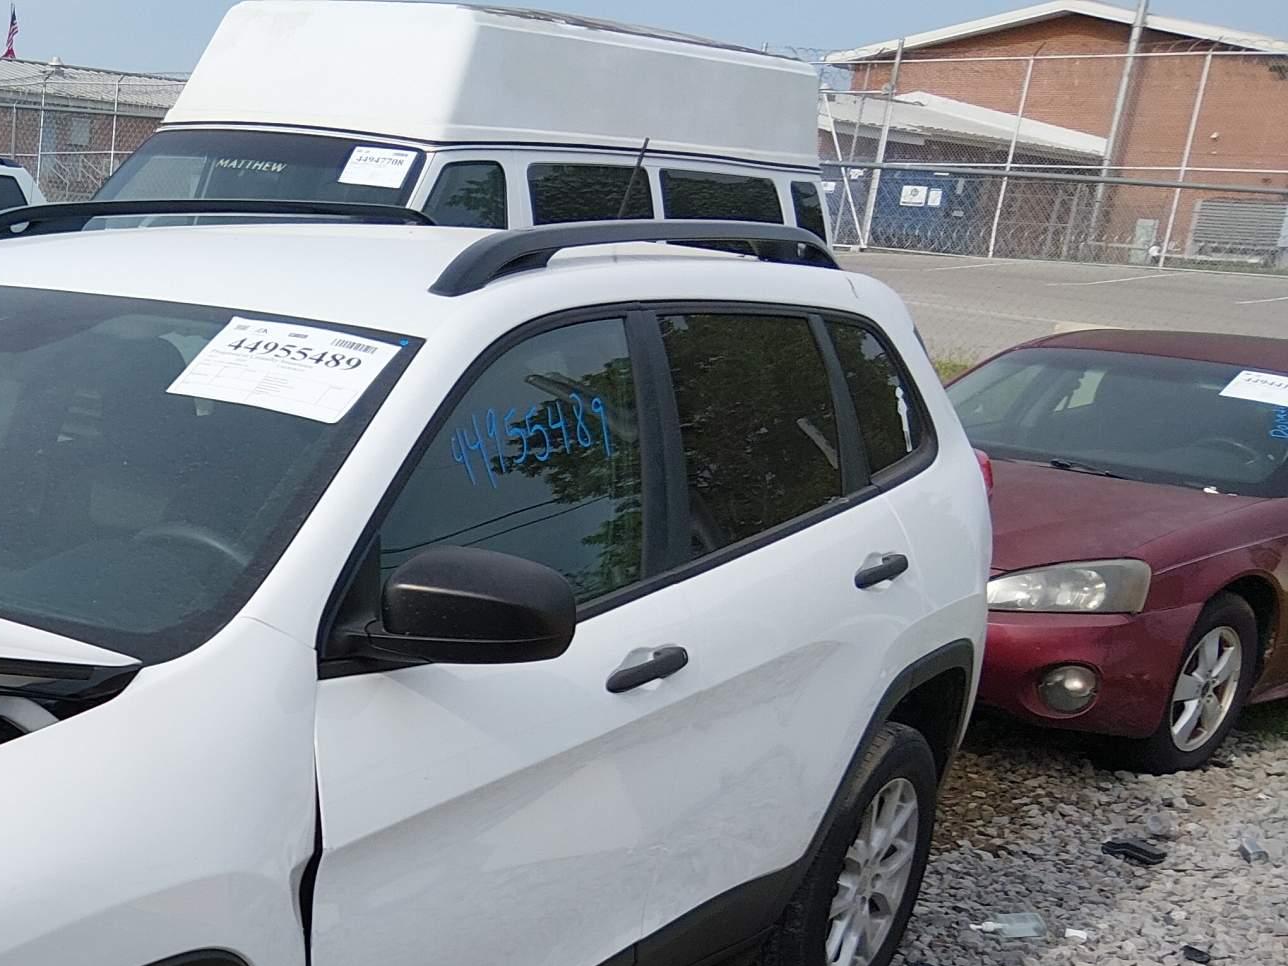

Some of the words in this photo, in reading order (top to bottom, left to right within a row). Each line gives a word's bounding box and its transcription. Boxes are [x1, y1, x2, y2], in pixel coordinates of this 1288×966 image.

[216, 158, 288, 173] MATTHEW
[227, 337, 362, 371] 44955489
[451, 392, 611, 489] 44955489
